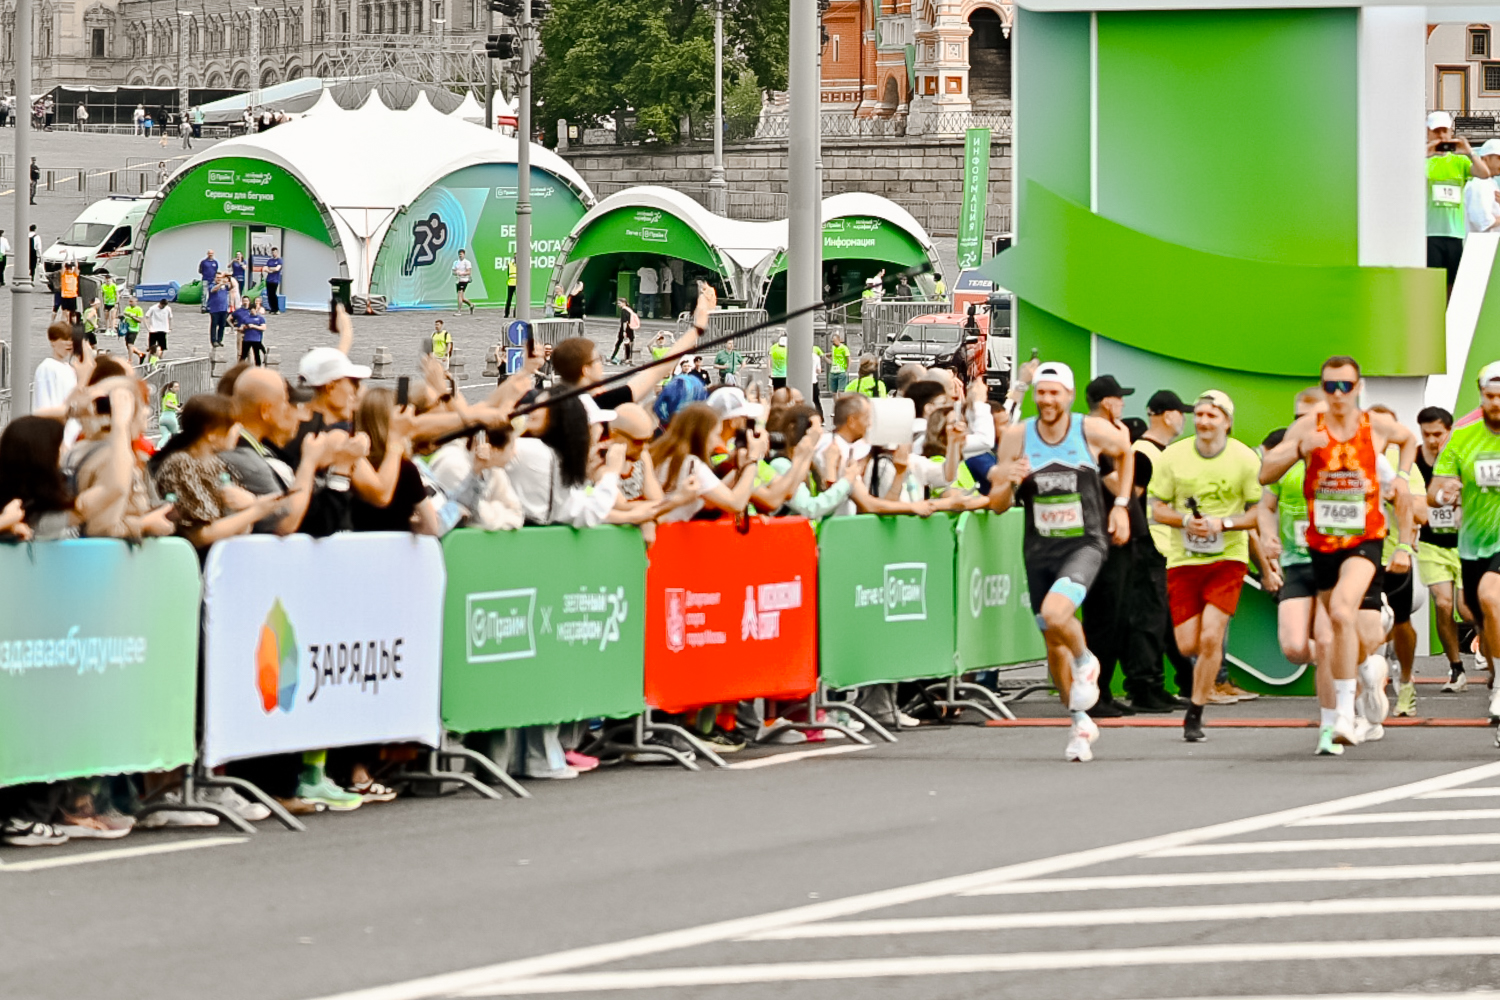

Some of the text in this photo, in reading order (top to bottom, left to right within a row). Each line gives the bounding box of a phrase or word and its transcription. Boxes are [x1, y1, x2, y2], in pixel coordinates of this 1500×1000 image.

[967, 137, 981, 231] ИНФОРМАЦИЯ
[500, 225, 532, 238] БЕ
[508, 237, 566, 254] ПМОГА
[824, 236, 876, 249] Информация
[563, 585, 607, 613] зелёный
[897, 577, 921, 607] Прайм
[984, 574, 1011, 607] СБЕР
[486, 607, 527, 645] Прайм
[556, 613, 603, 647] марафон
[307, 637, 404, 703] ЗАРЯДЬЕ
